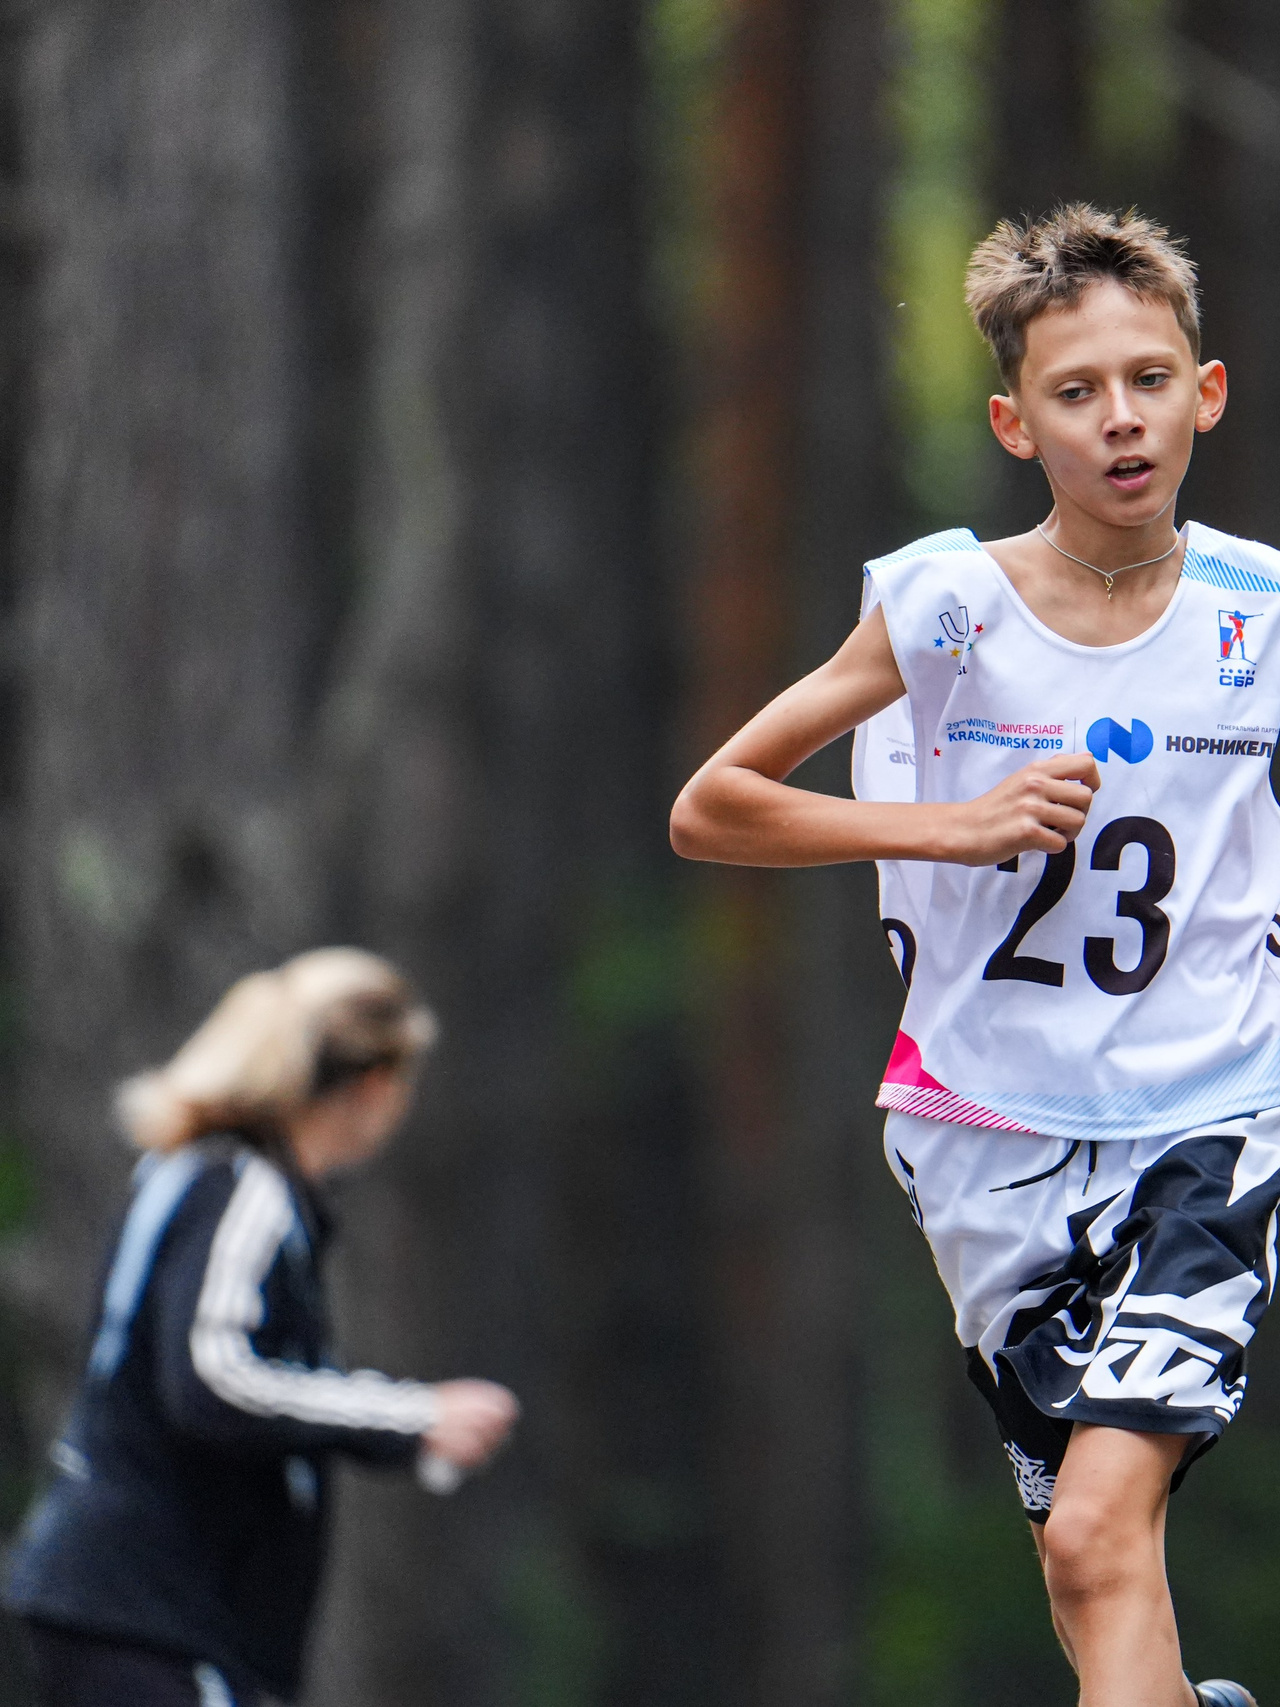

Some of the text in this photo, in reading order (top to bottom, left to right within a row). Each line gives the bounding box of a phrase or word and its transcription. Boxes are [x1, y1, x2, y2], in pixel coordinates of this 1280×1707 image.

[1219, 675, 1254, 687] СБР
[966, 718, 996, 731] WINTER
[997, 723, 1064, 735] UNIVERSIADE
[948, 731, 1063, 749] KRASNOYARSK 2019
[982, 816, 1176, 996] 23
